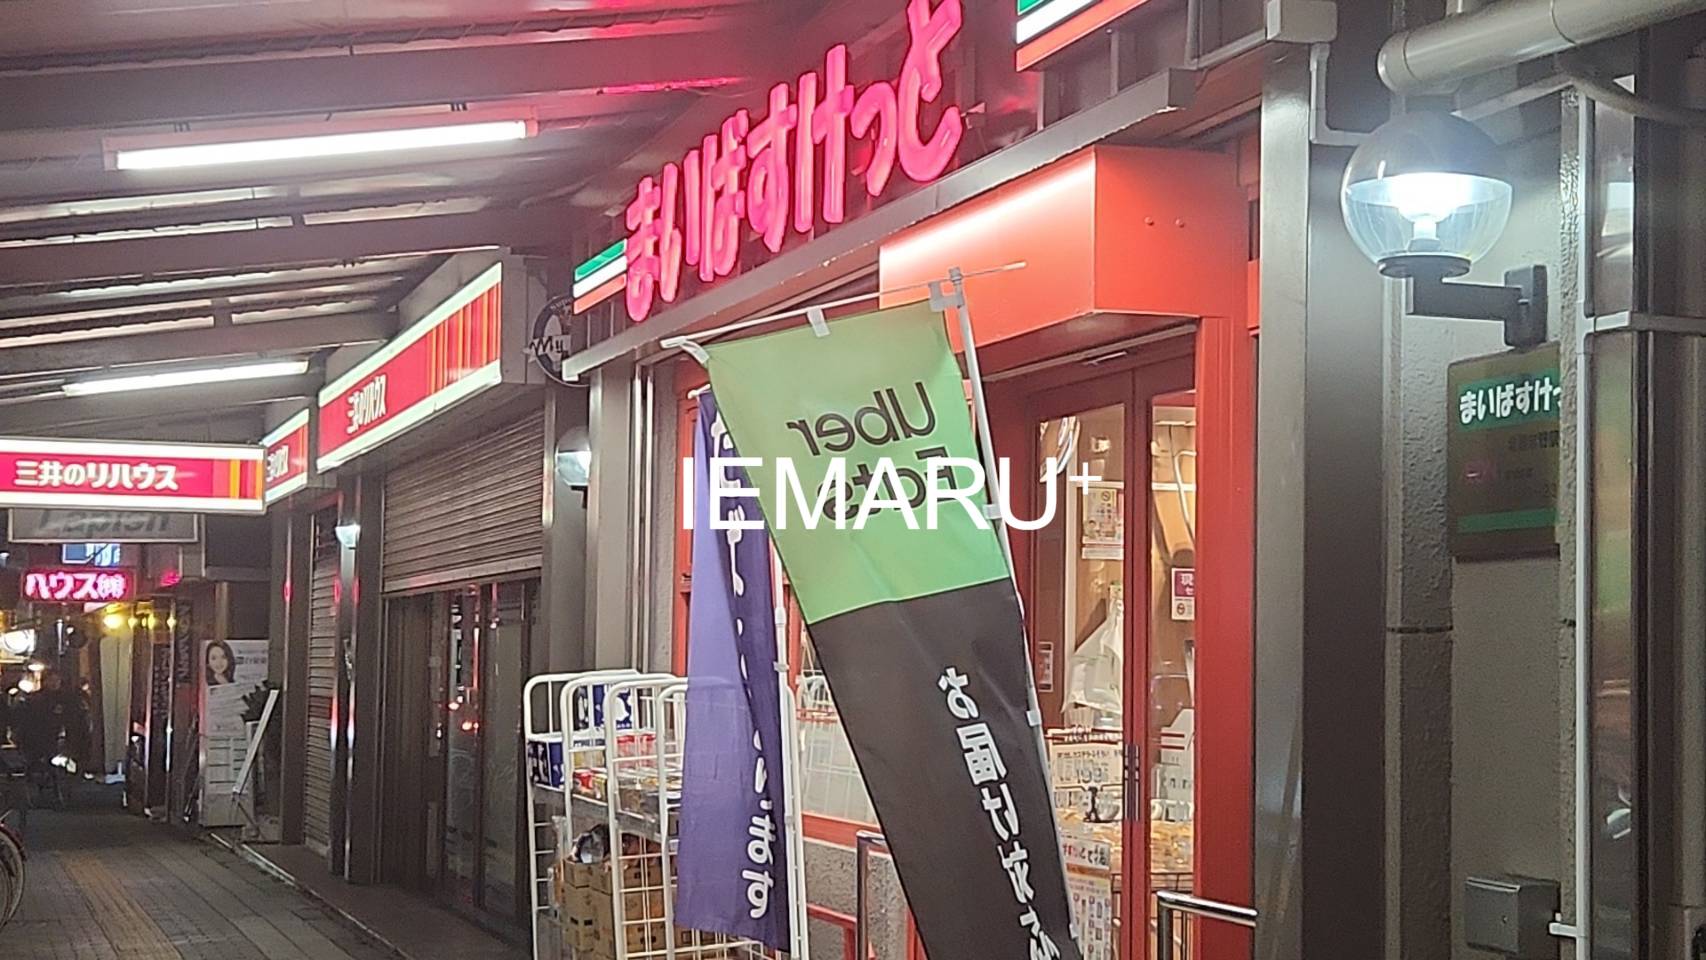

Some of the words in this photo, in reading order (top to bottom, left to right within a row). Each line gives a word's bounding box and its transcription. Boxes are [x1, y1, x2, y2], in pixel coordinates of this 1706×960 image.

[626, 0, 963, 322] まいばすけっと
[14, 460, 179, 491] 三井のリハウス
